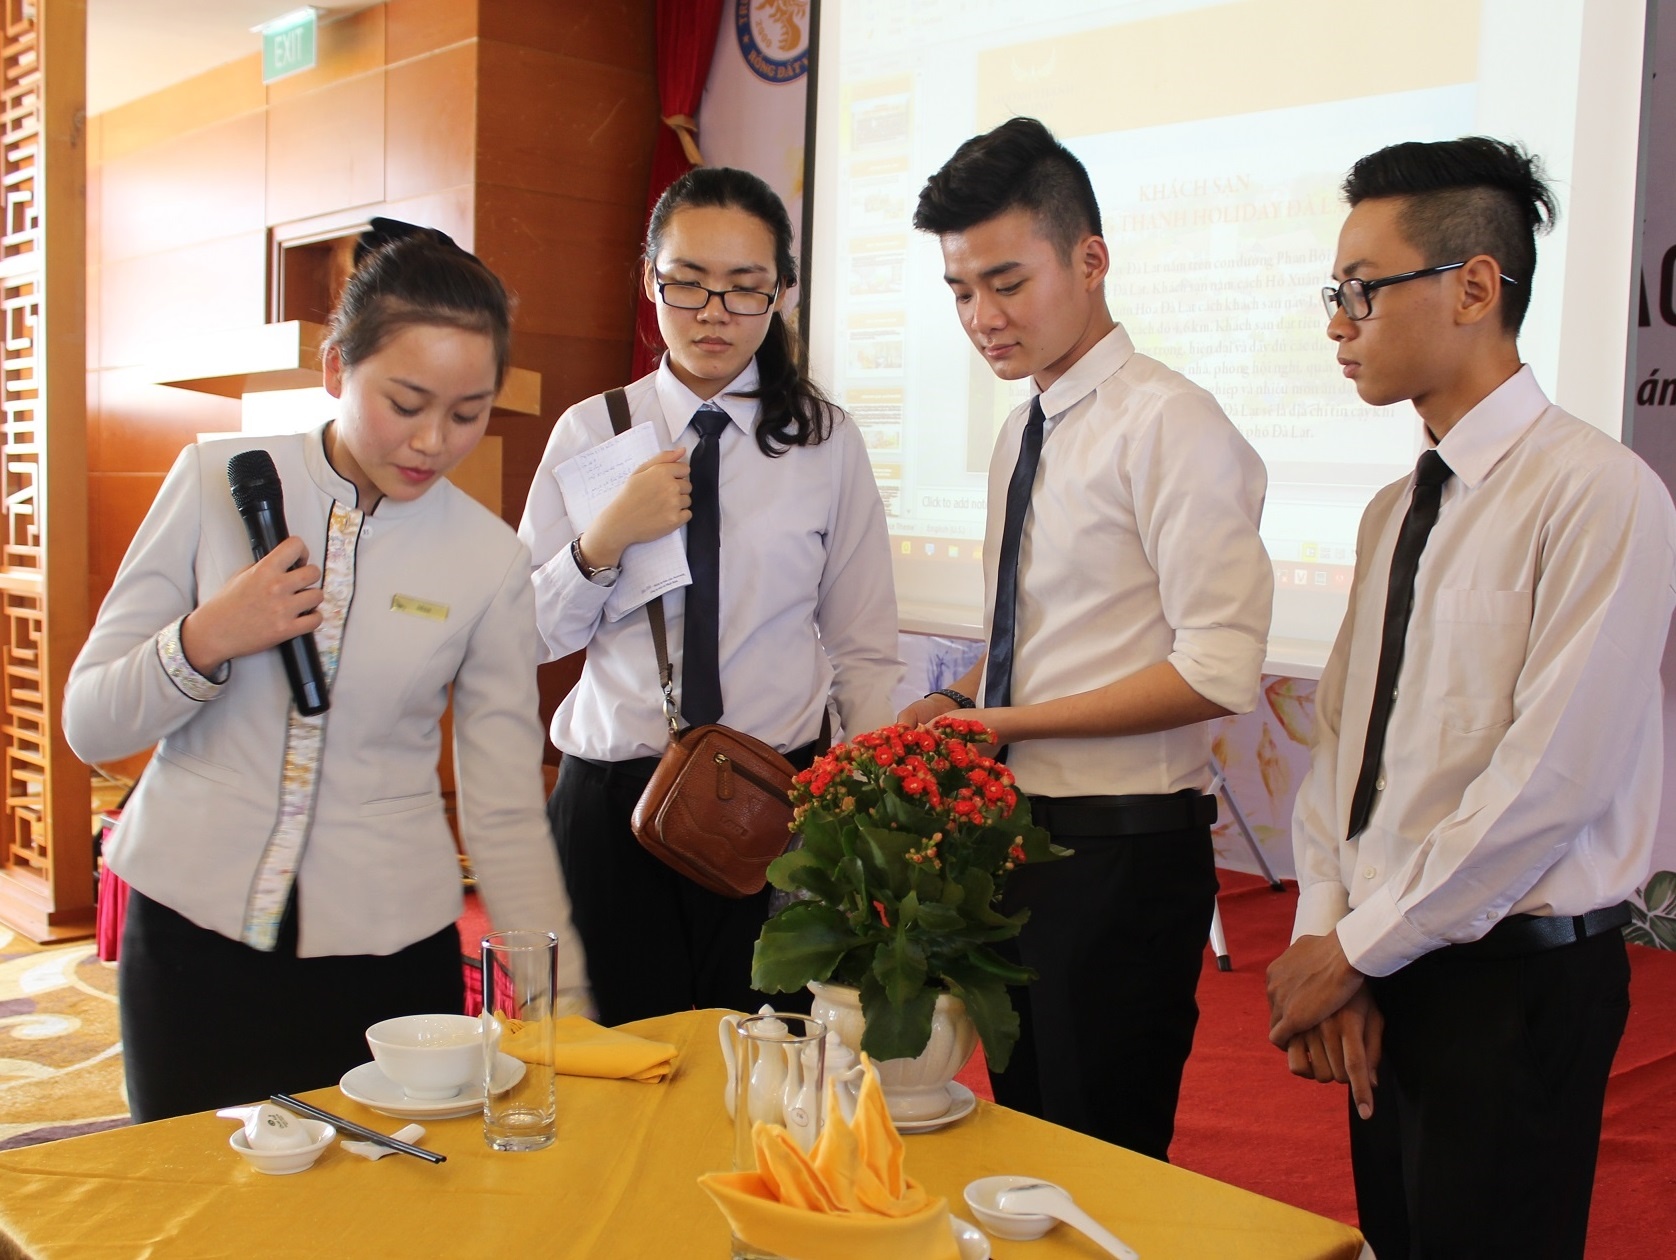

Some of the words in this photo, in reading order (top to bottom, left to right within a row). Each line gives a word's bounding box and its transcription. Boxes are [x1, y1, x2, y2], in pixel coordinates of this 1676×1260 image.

[274, 27, 304, 68] EXIT
[1139, 178, 1208, 202] KHÁCH
[1212, 173, 1251, 198] SẠN
[1120, 206, 1187, 233] THANH
[1192, 200, 1281, 227] HOLIDAY
[922, 496, 941, 508] Click
[942, 497, 951, 508] to
[953, 498, 969, 510] add
